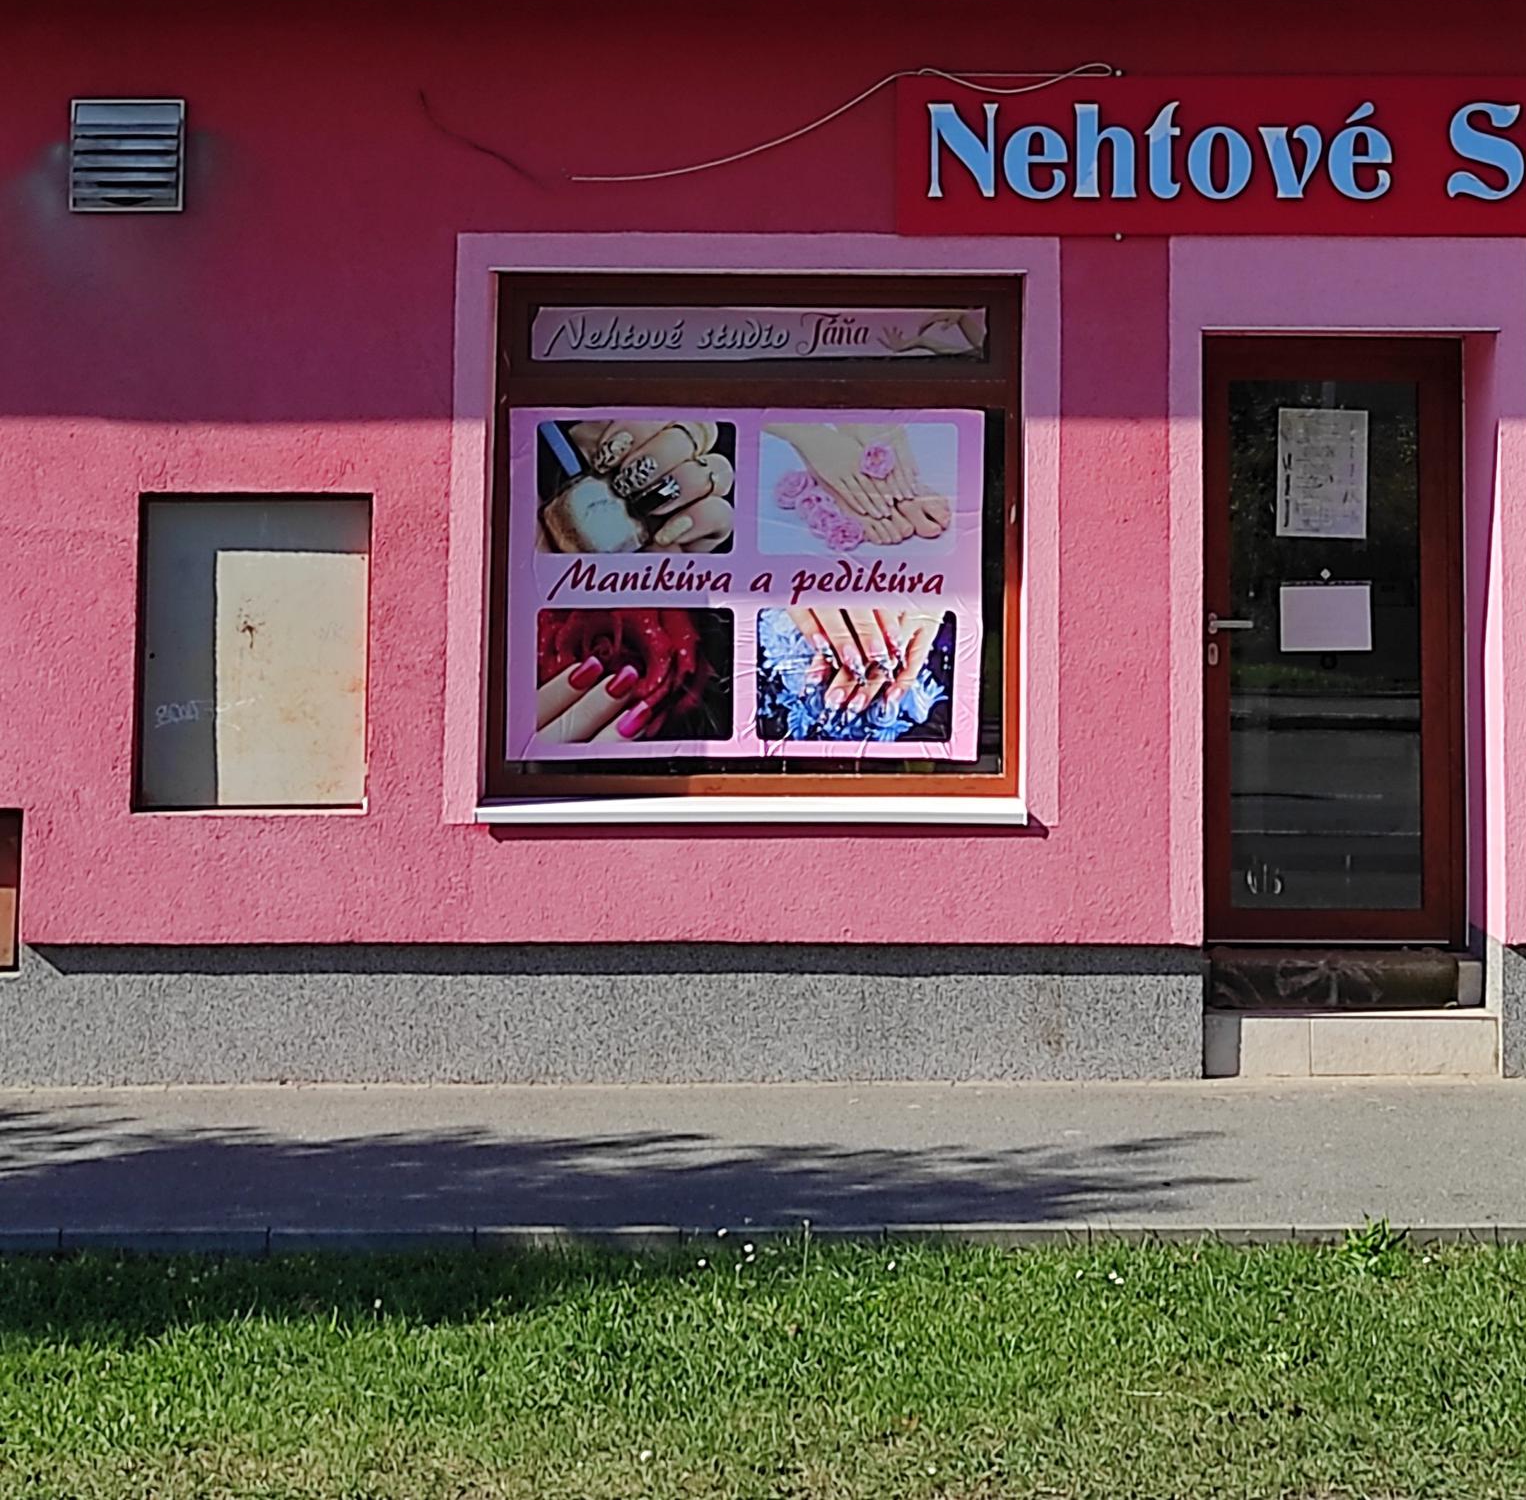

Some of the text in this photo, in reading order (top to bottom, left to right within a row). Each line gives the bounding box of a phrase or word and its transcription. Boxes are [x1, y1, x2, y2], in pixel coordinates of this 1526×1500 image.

[926, 101, 1393, 200] Nehtové
[543, 313, 870, 356] Nehtové studio Táňa
[547, 558, 945, 605] Manikúra a pedikúra
